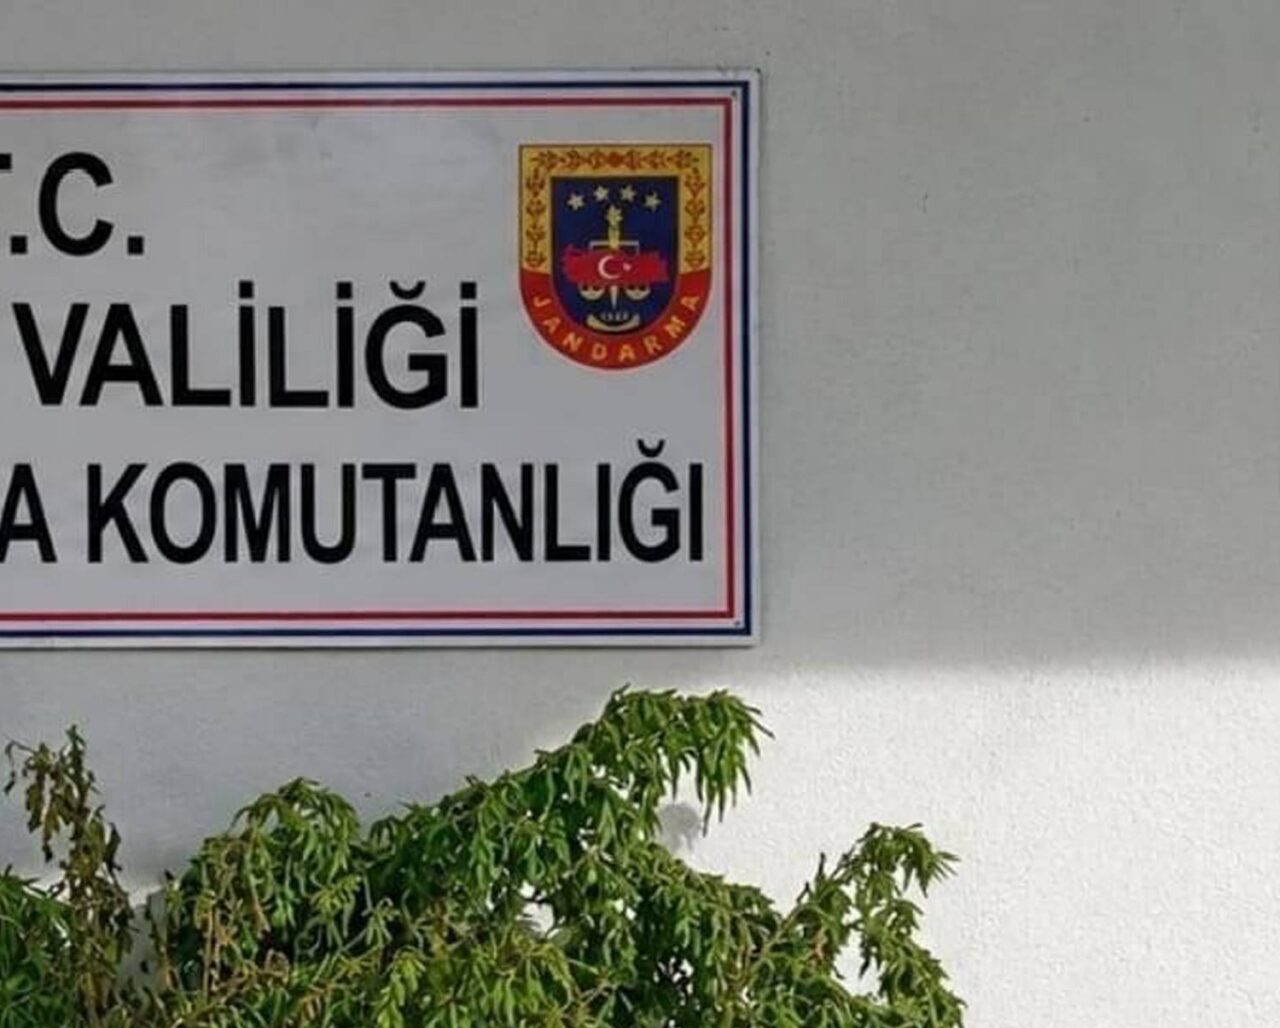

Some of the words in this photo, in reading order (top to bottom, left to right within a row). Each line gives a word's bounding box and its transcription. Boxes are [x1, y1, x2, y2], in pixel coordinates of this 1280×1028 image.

[12, 280, 480, 410] VALİLİĞİ
[533, 295, 700, 362] JANDARMA
[87, 439, 704, 566] KOMUTANLIĞI
